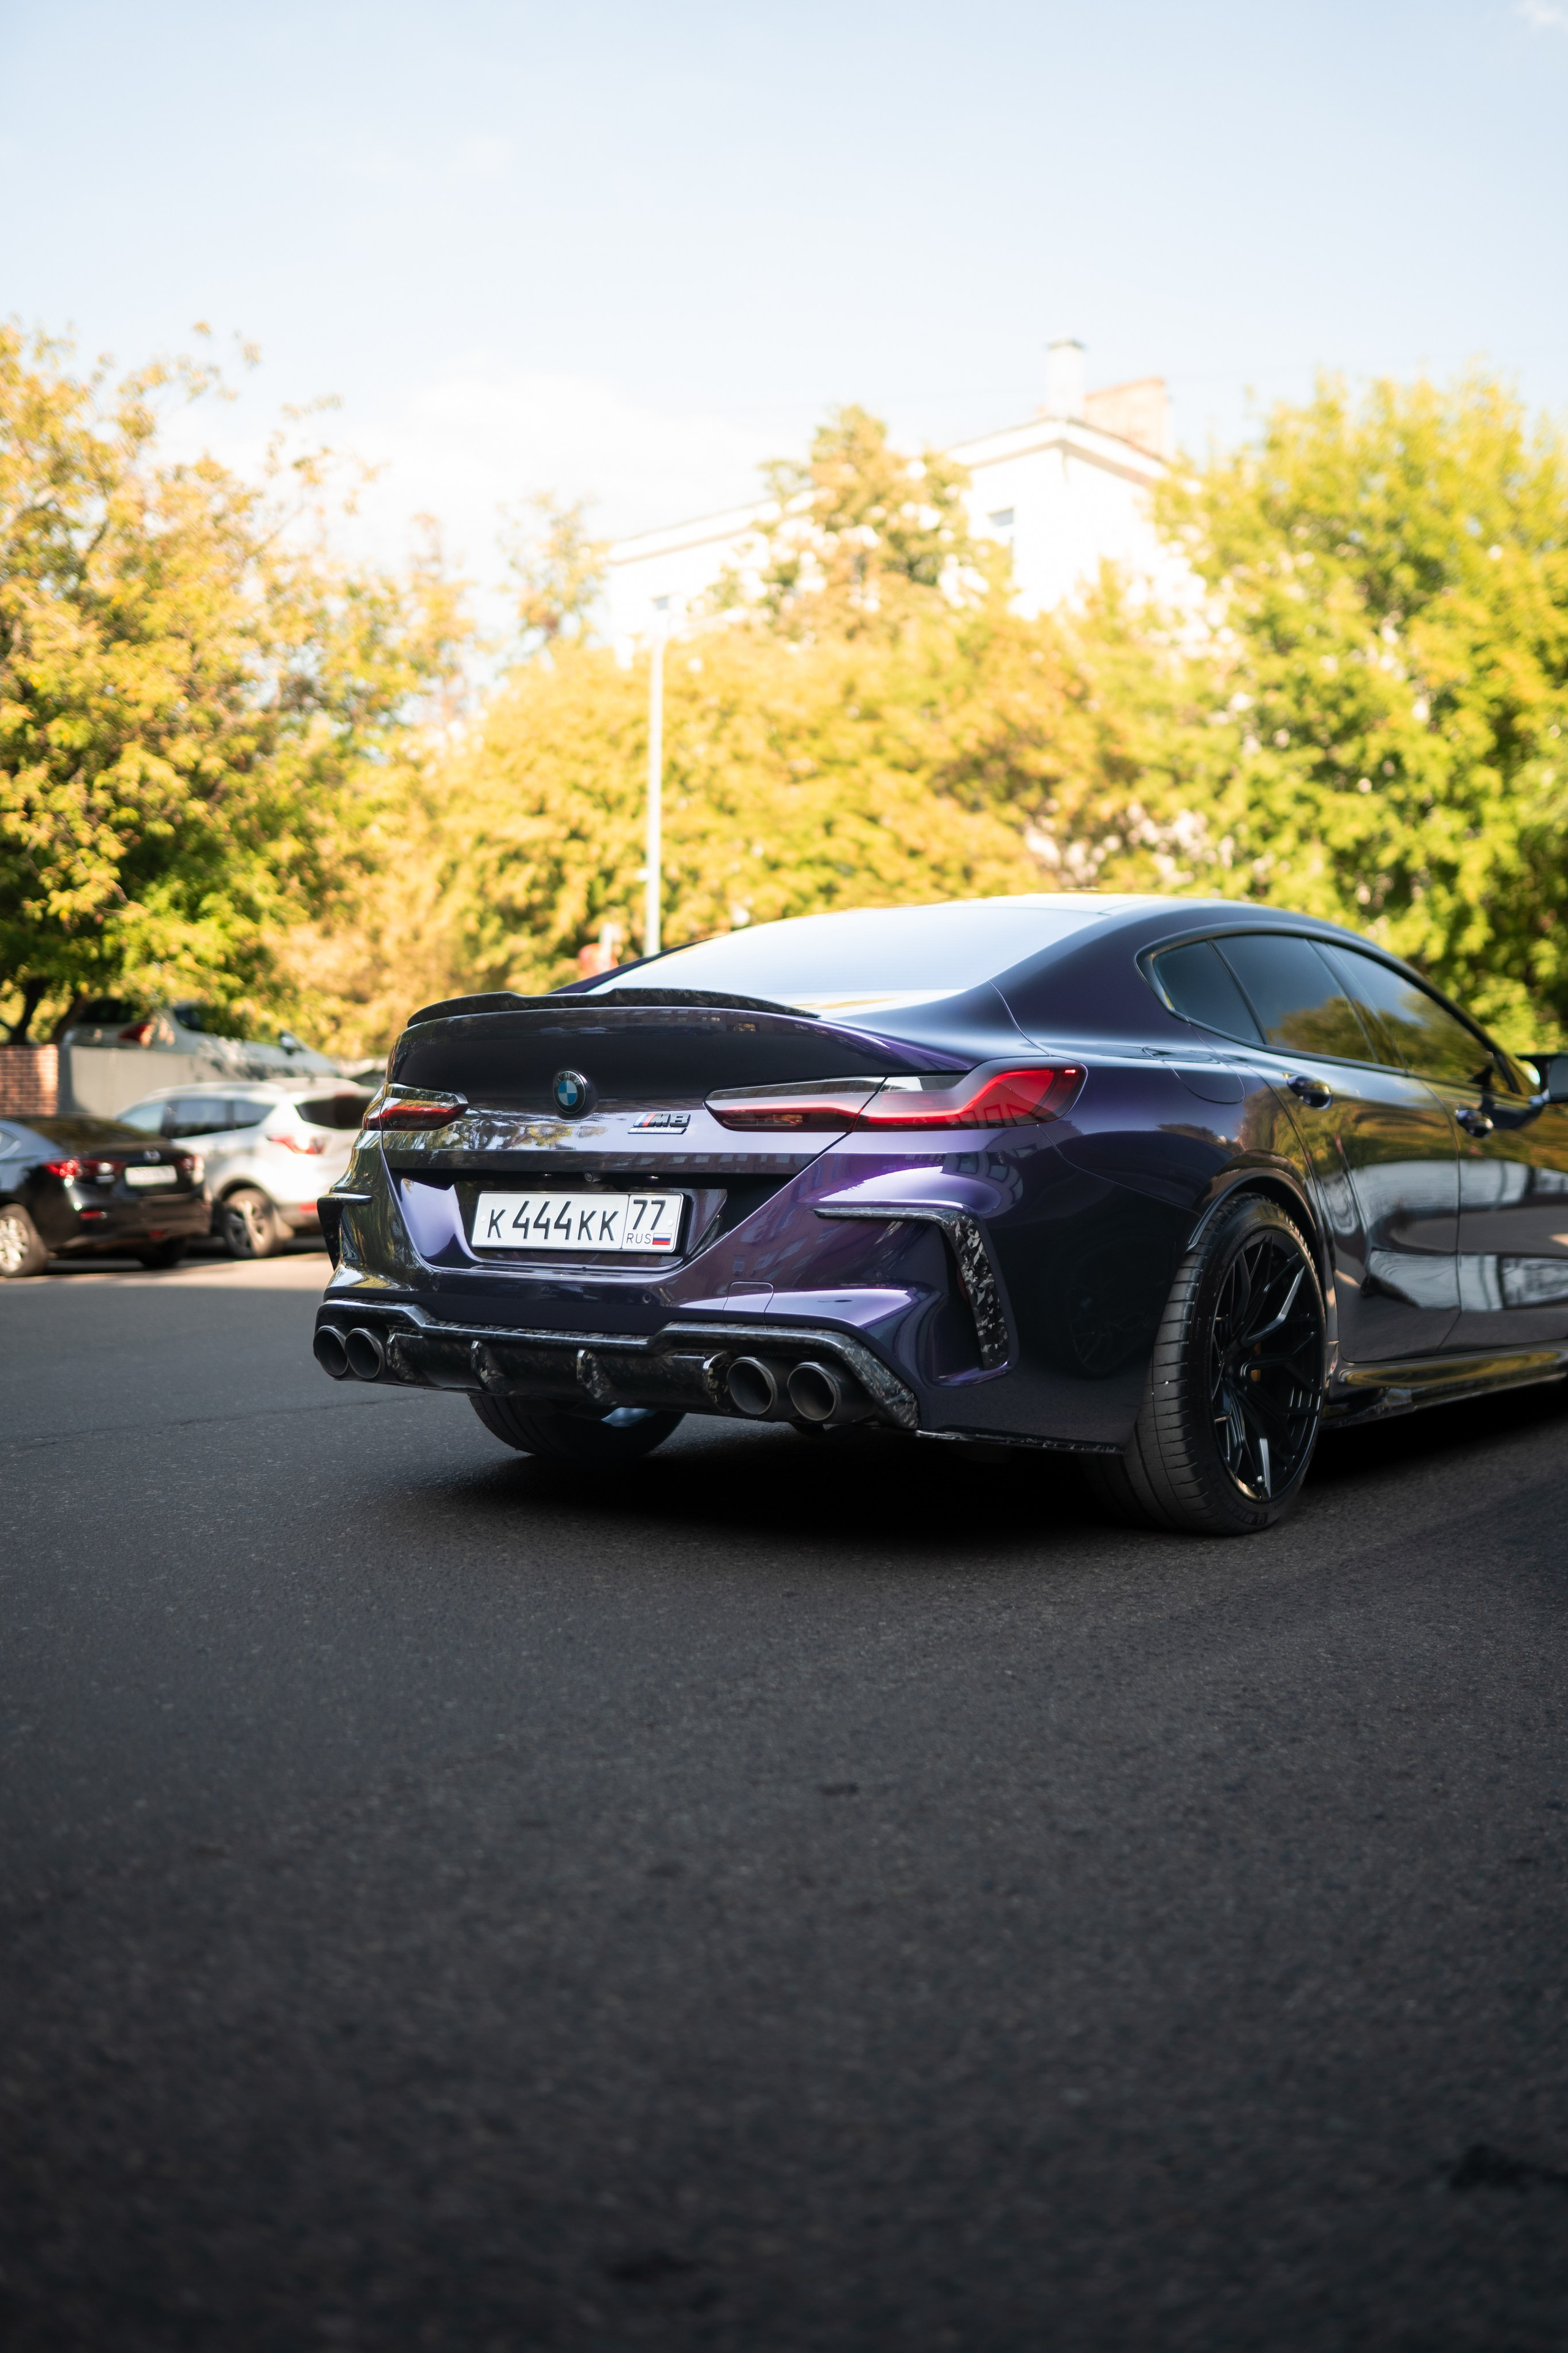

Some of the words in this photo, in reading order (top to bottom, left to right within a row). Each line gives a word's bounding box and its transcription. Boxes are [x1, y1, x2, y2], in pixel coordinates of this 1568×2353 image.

[647, 1114, 691, 1127] M8
[633, 1199, 666, 1230] 77
[626, 1233, 651, 1244] RUS
